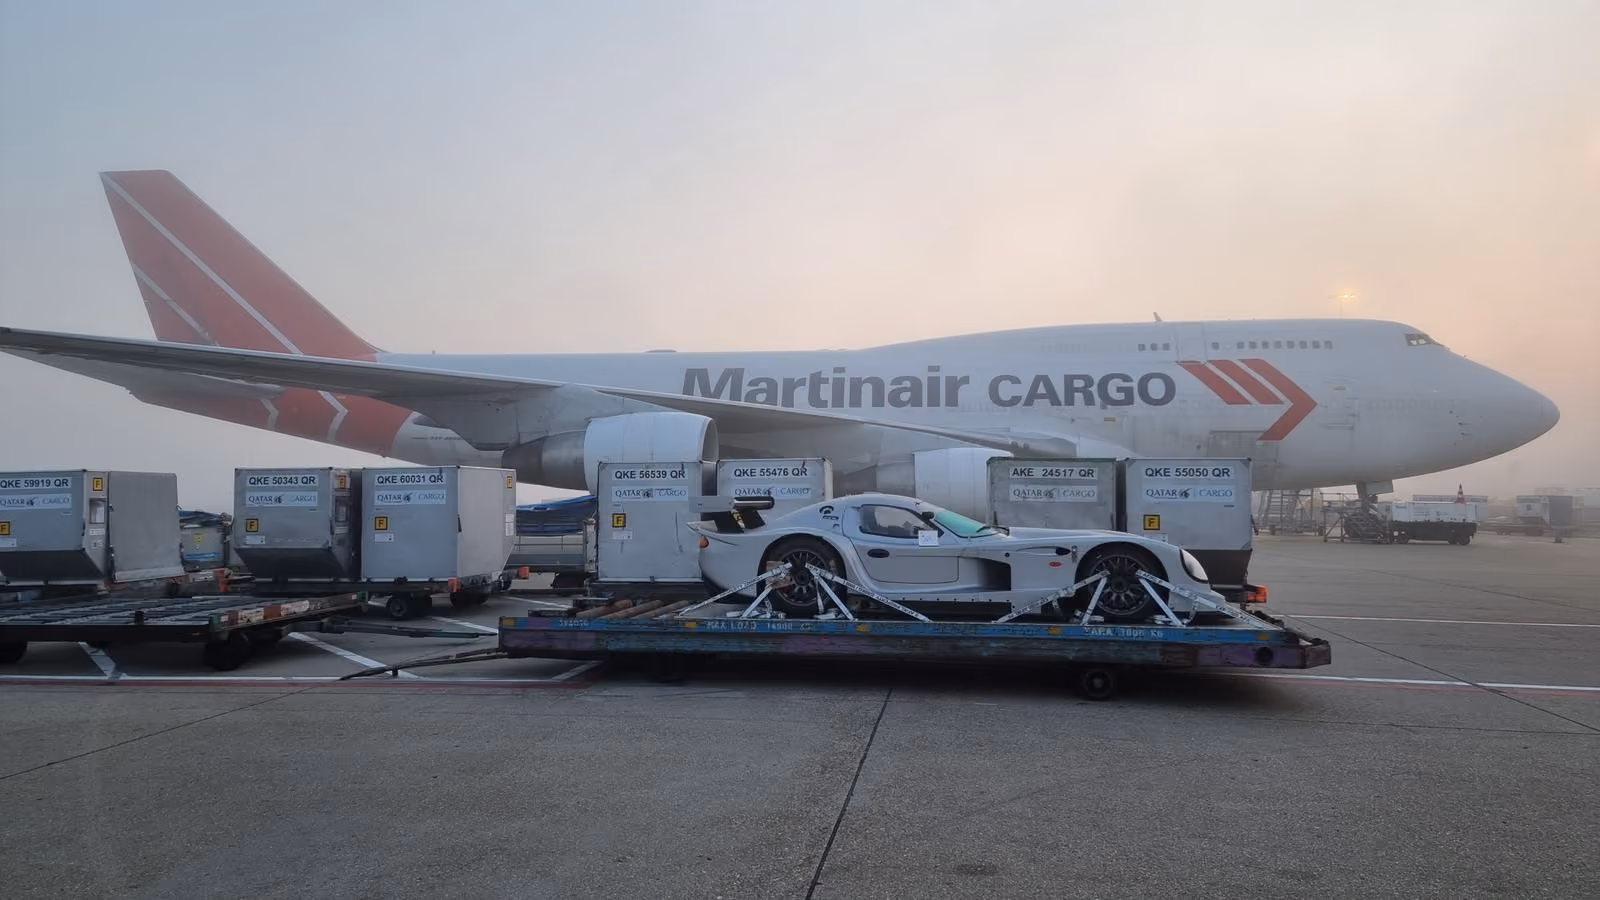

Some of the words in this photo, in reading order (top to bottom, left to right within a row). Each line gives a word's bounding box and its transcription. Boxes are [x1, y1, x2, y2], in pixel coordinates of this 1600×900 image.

[682, 365, 970, 409] Martinair
[988, 372, 1177, 408] CARGO
[615, 470, 636, 479] QKE
[640, 470, 667, 479] 56539
[670, 470, 685, 479] QR
[734, 468, 756, 477] QKE
[760, 468, 788, 477] 55476
[791, 467, 807, 477] QR
[1012, 468, 1034, 477] AKE
[1042, 468, 1074, 477] 24517
[1079, 469, 1094, 477] QR
[1145, 467, 1171, 477] QKE
[1175, 468, 1208, 477] 55050
[1212, 467, 1230, 477] QR
[1, 479, 21, 488] QKE
[24, 479, 51, 488] 59919
[54, 478, 69, 487] QR
[248, 476, 269, 486] QKE
[272, 476, 299, 485] 50343
[301, 476, 316, 485] QR
[377, 475, 398, 484] QKE
[400, 474, 425, 484] 60031
[429, 474, 444, 484] QR
[615, 489, 640, 497] QATAR
[658, 489, 687, 497] CARGO
[735, 488, 760, 496] QATAR
[780, 487, 809, 495] CARGO
[1013, 489, 1042, 497] QATAR
[1063, 489, 1096, 497] CARGO
[1146, 489, 1177, 497] QATAR
[1200, 489, 1233, 497] CARGO
[249, 495, 273, 503] QATAR
[377, 494, 402, 502] QATAR
